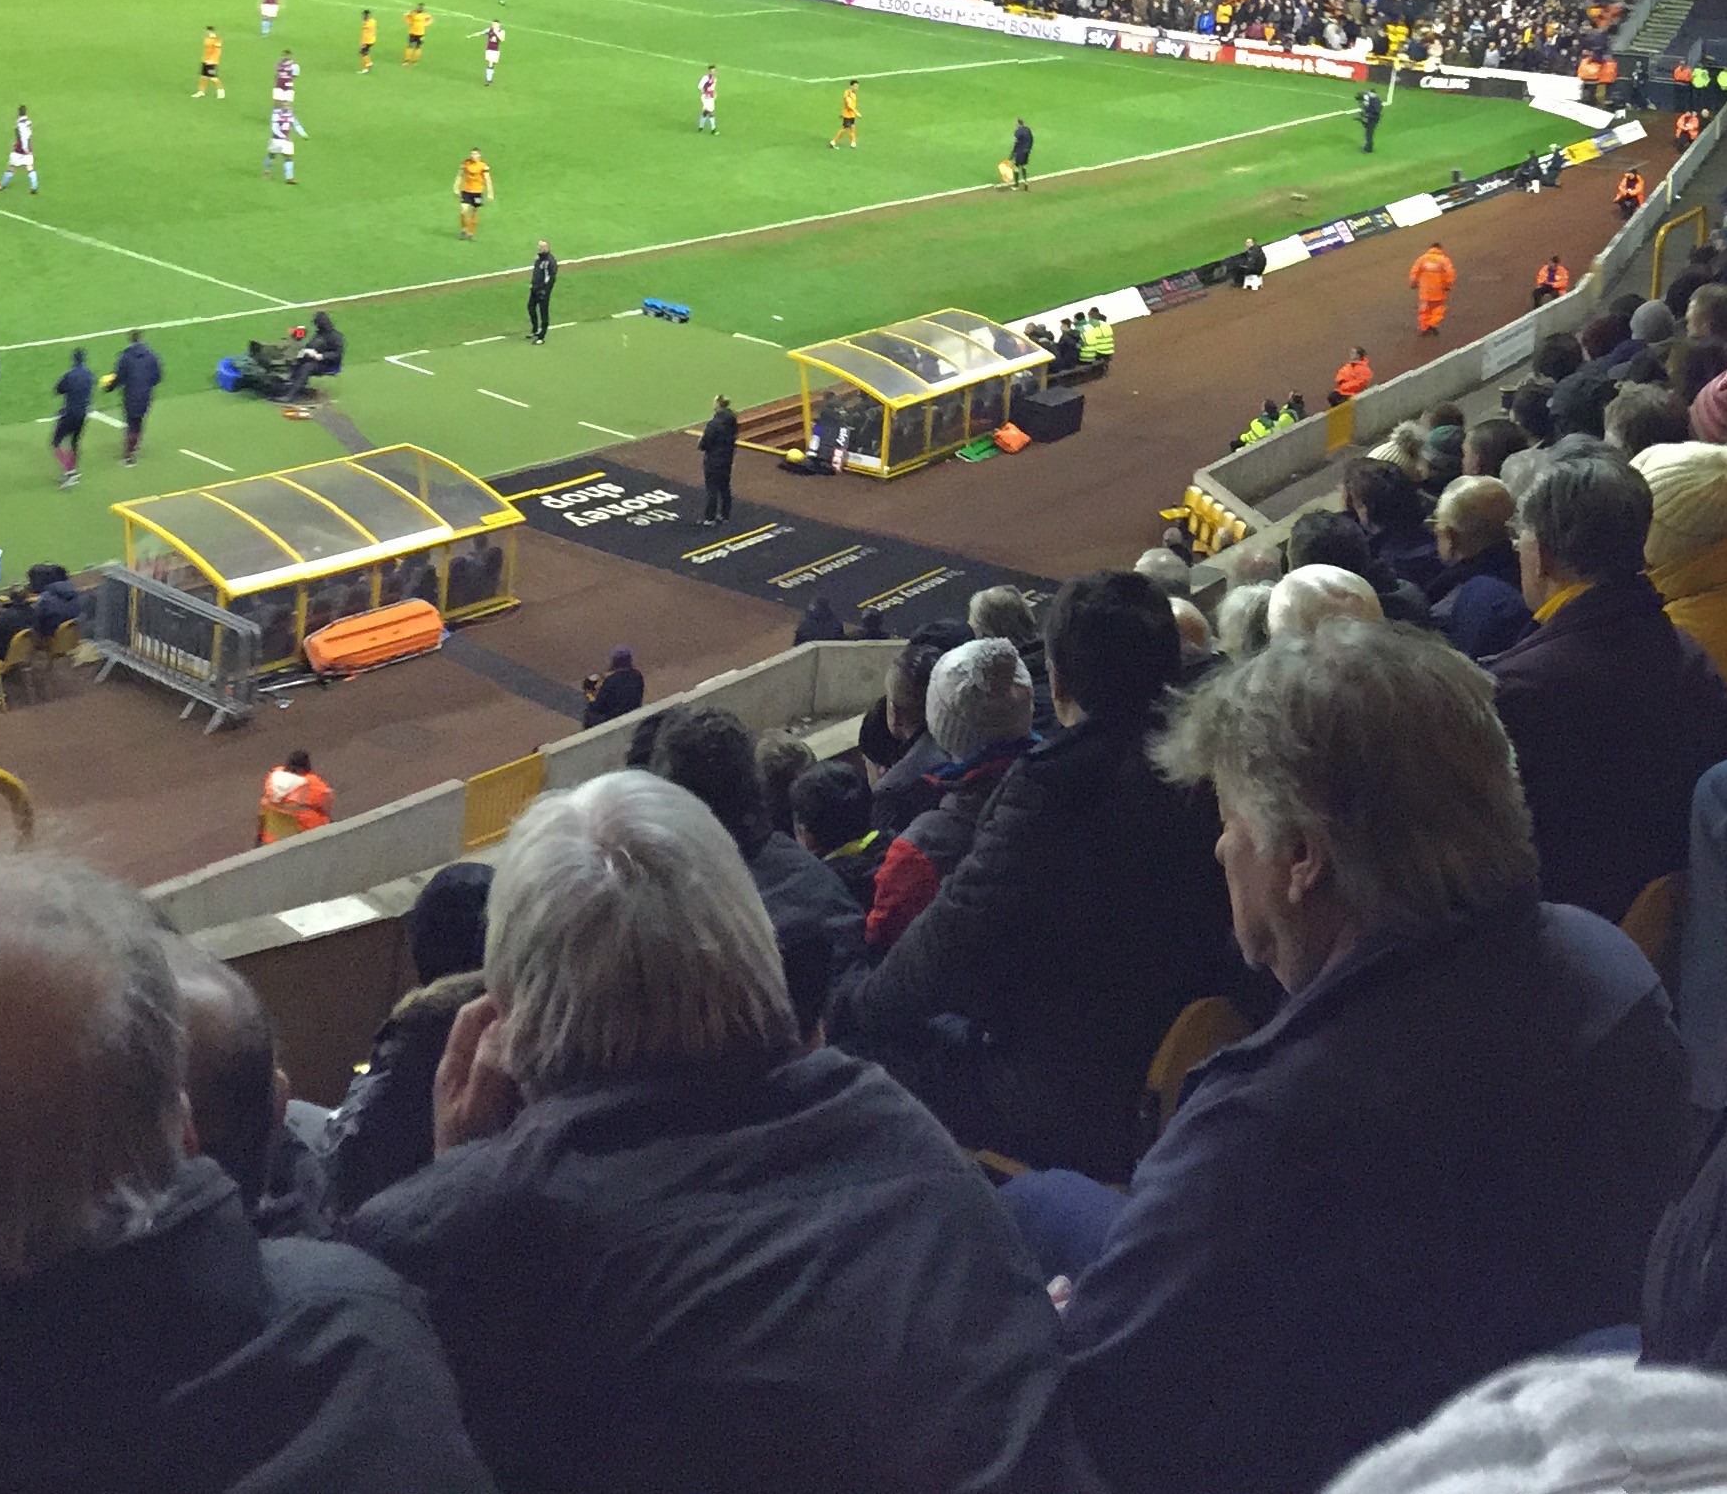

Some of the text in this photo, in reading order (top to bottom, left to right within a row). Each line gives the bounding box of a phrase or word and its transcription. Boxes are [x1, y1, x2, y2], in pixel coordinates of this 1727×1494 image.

[913, 1, 953, 22] CASH
[955, 8, 1006, 30] MATCH
[1007, 17, 1062, 41] BONUS
[1088, 29, 1151, 53] sky BET
[1189, 43, 1217, 62] BET
[541, 481, 626, 510] shop
[563, 488, 680, 529] money
[627, 508, 681, 527] the
